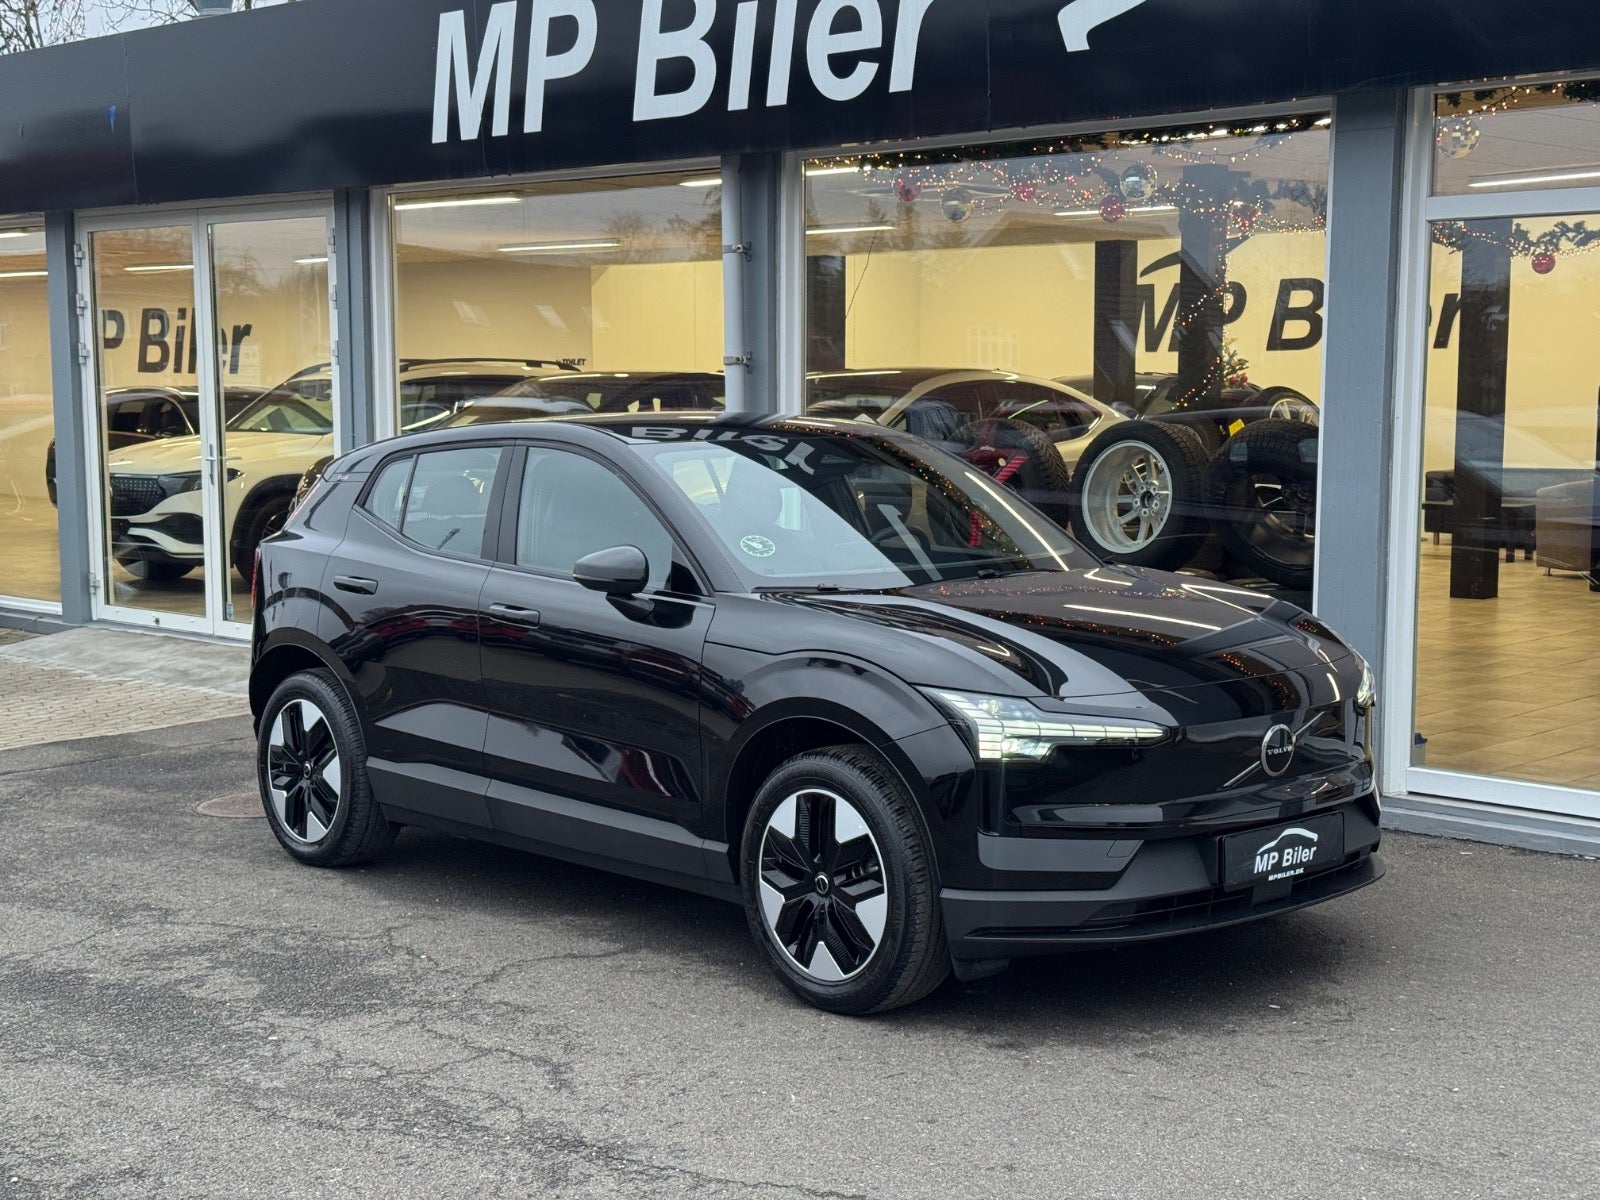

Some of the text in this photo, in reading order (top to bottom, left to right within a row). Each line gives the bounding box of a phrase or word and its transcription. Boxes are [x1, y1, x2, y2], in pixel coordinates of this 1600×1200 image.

[431, 0, 934, 144] MP Biler
[137, 307, 253, 375] Bilr
[1267, 745, 1293, 756] VOLVO
[1253, 845, 1317, 874] MP Biler
[1268, 867, 1304, 882] MPBILER.DK
